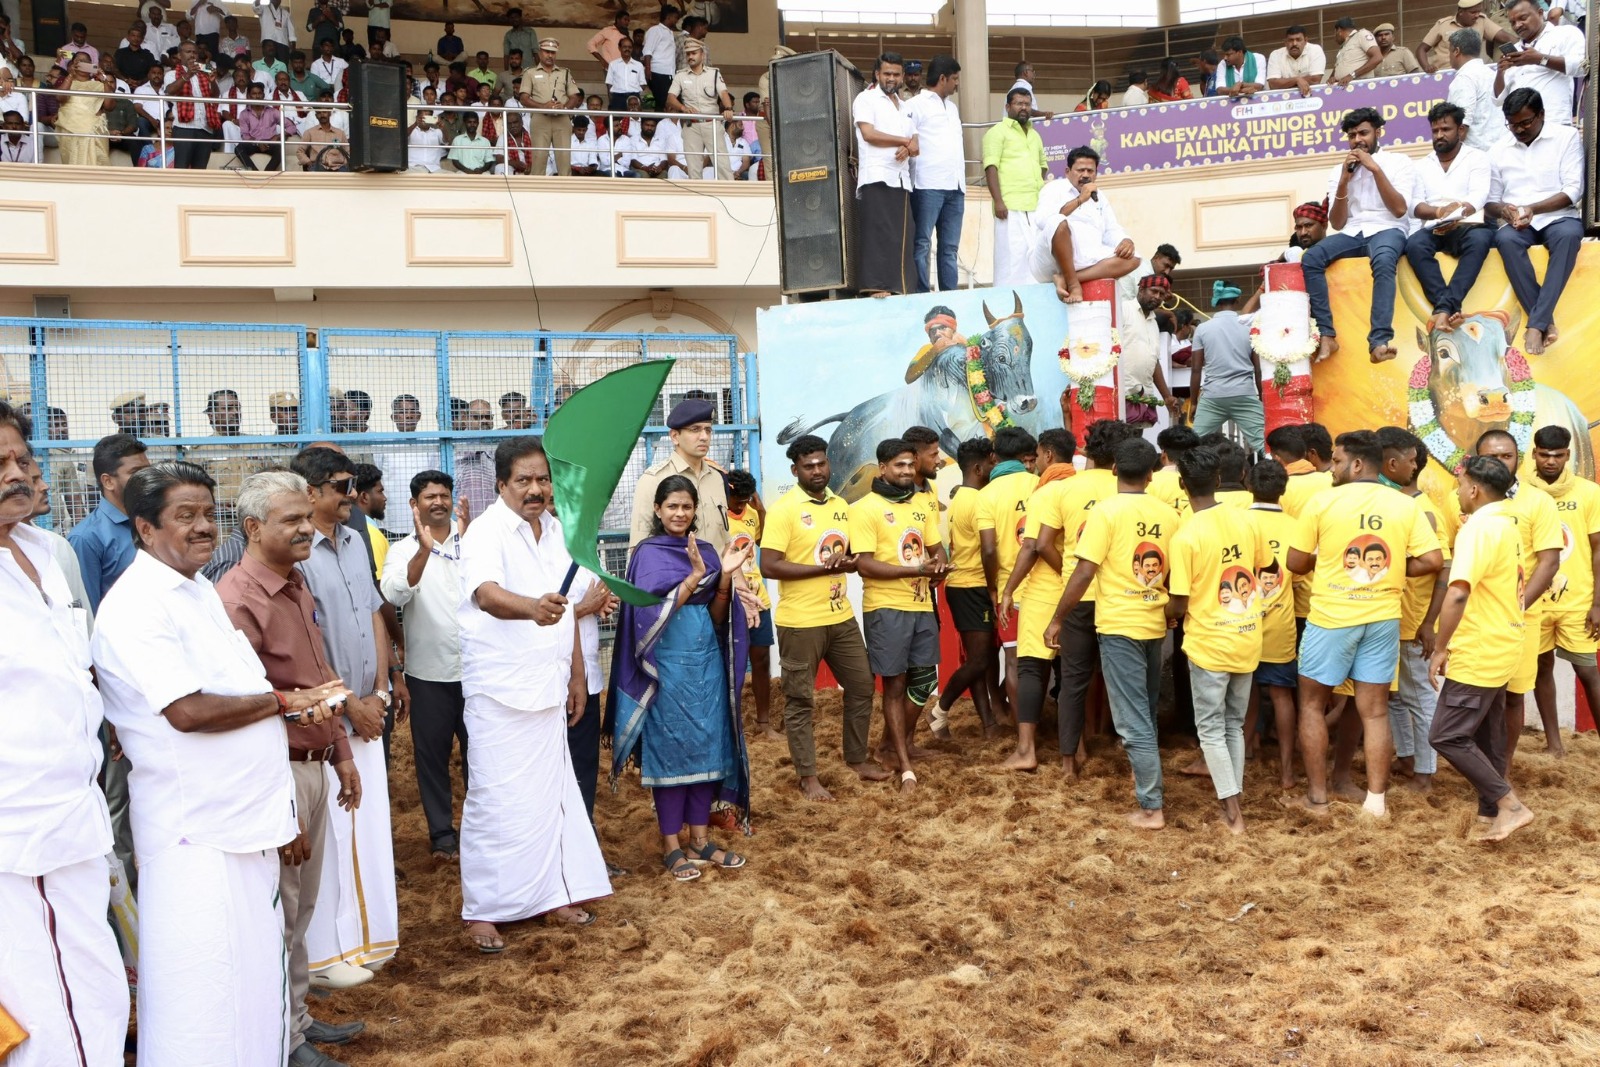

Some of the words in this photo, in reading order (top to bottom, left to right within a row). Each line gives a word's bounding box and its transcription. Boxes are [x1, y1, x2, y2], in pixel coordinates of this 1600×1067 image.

[1120, 122, 1240, 149] KANGEYAN'S
[1246, 113, 1317, 137] JUNIOR
[1402, 98, 1446, 118] CU
[1176, 133, 1286, 160] JALLIKATTU
[1290, 128, 1334, 148] FEST
[1556, 501, 1577, 511] 28
[833, 511, 849, 522] 44
[912, 511, 926, 523] 32
[1359, 513, 1383, 531] 16
[1136, 521, 1163, 539] 34
[983, 610, 990, 623] 1
[1238, 622, 1256, 633] 2025
